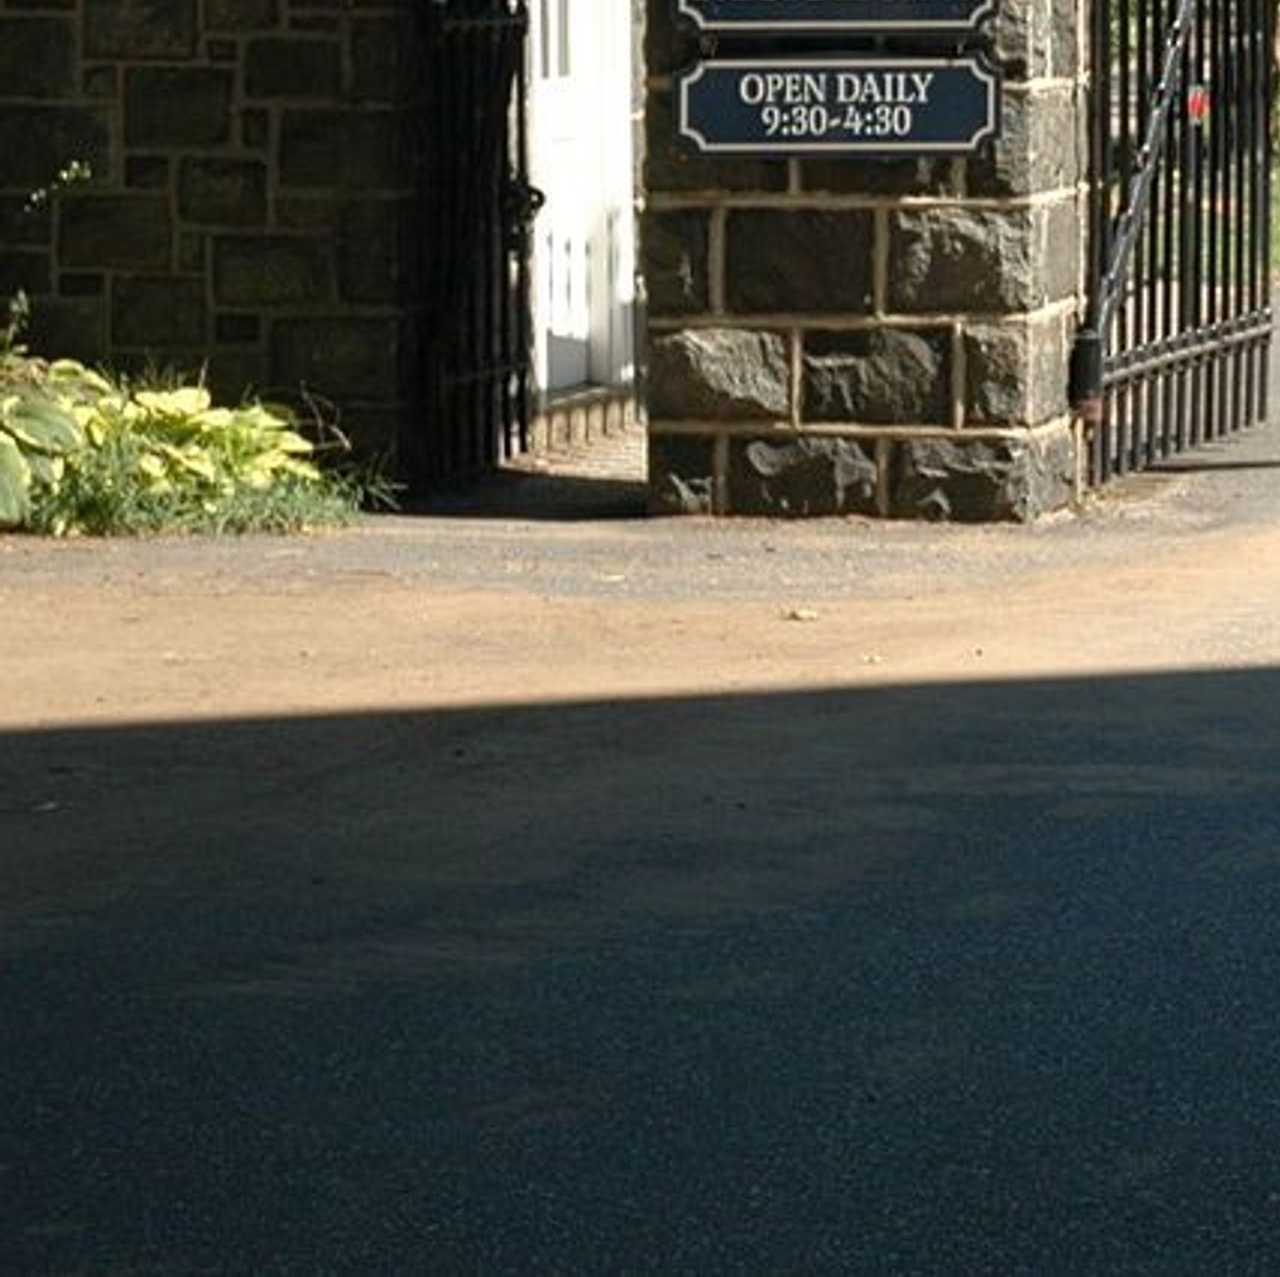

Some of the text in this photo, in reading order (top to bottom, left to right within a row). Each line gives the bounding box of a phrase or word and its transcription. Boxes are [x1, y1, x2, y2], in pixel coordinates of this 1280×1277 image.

[741, 73, 933, 103] OPEN DAILY
[762, 105, 911, 134] 9:30-4:30
